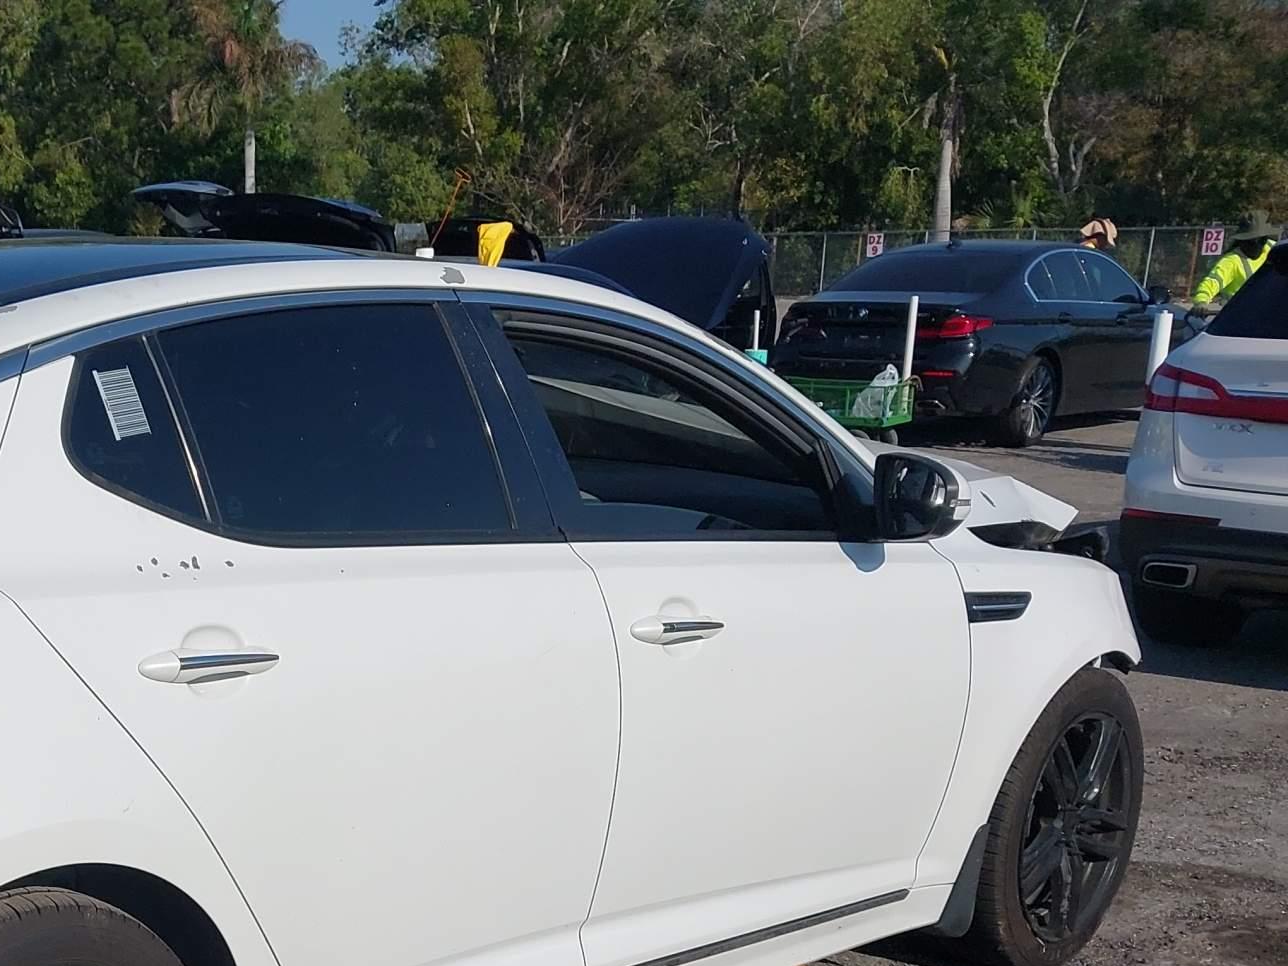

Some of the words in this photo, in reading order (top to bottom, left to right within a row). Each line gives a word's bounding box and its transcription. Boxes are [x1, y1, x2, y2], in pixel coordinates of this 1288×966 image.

[868, 235, 882, 245] DZ
[1204, 230, 1224, 242] DZ
[871, 245, 878, 255] 9
